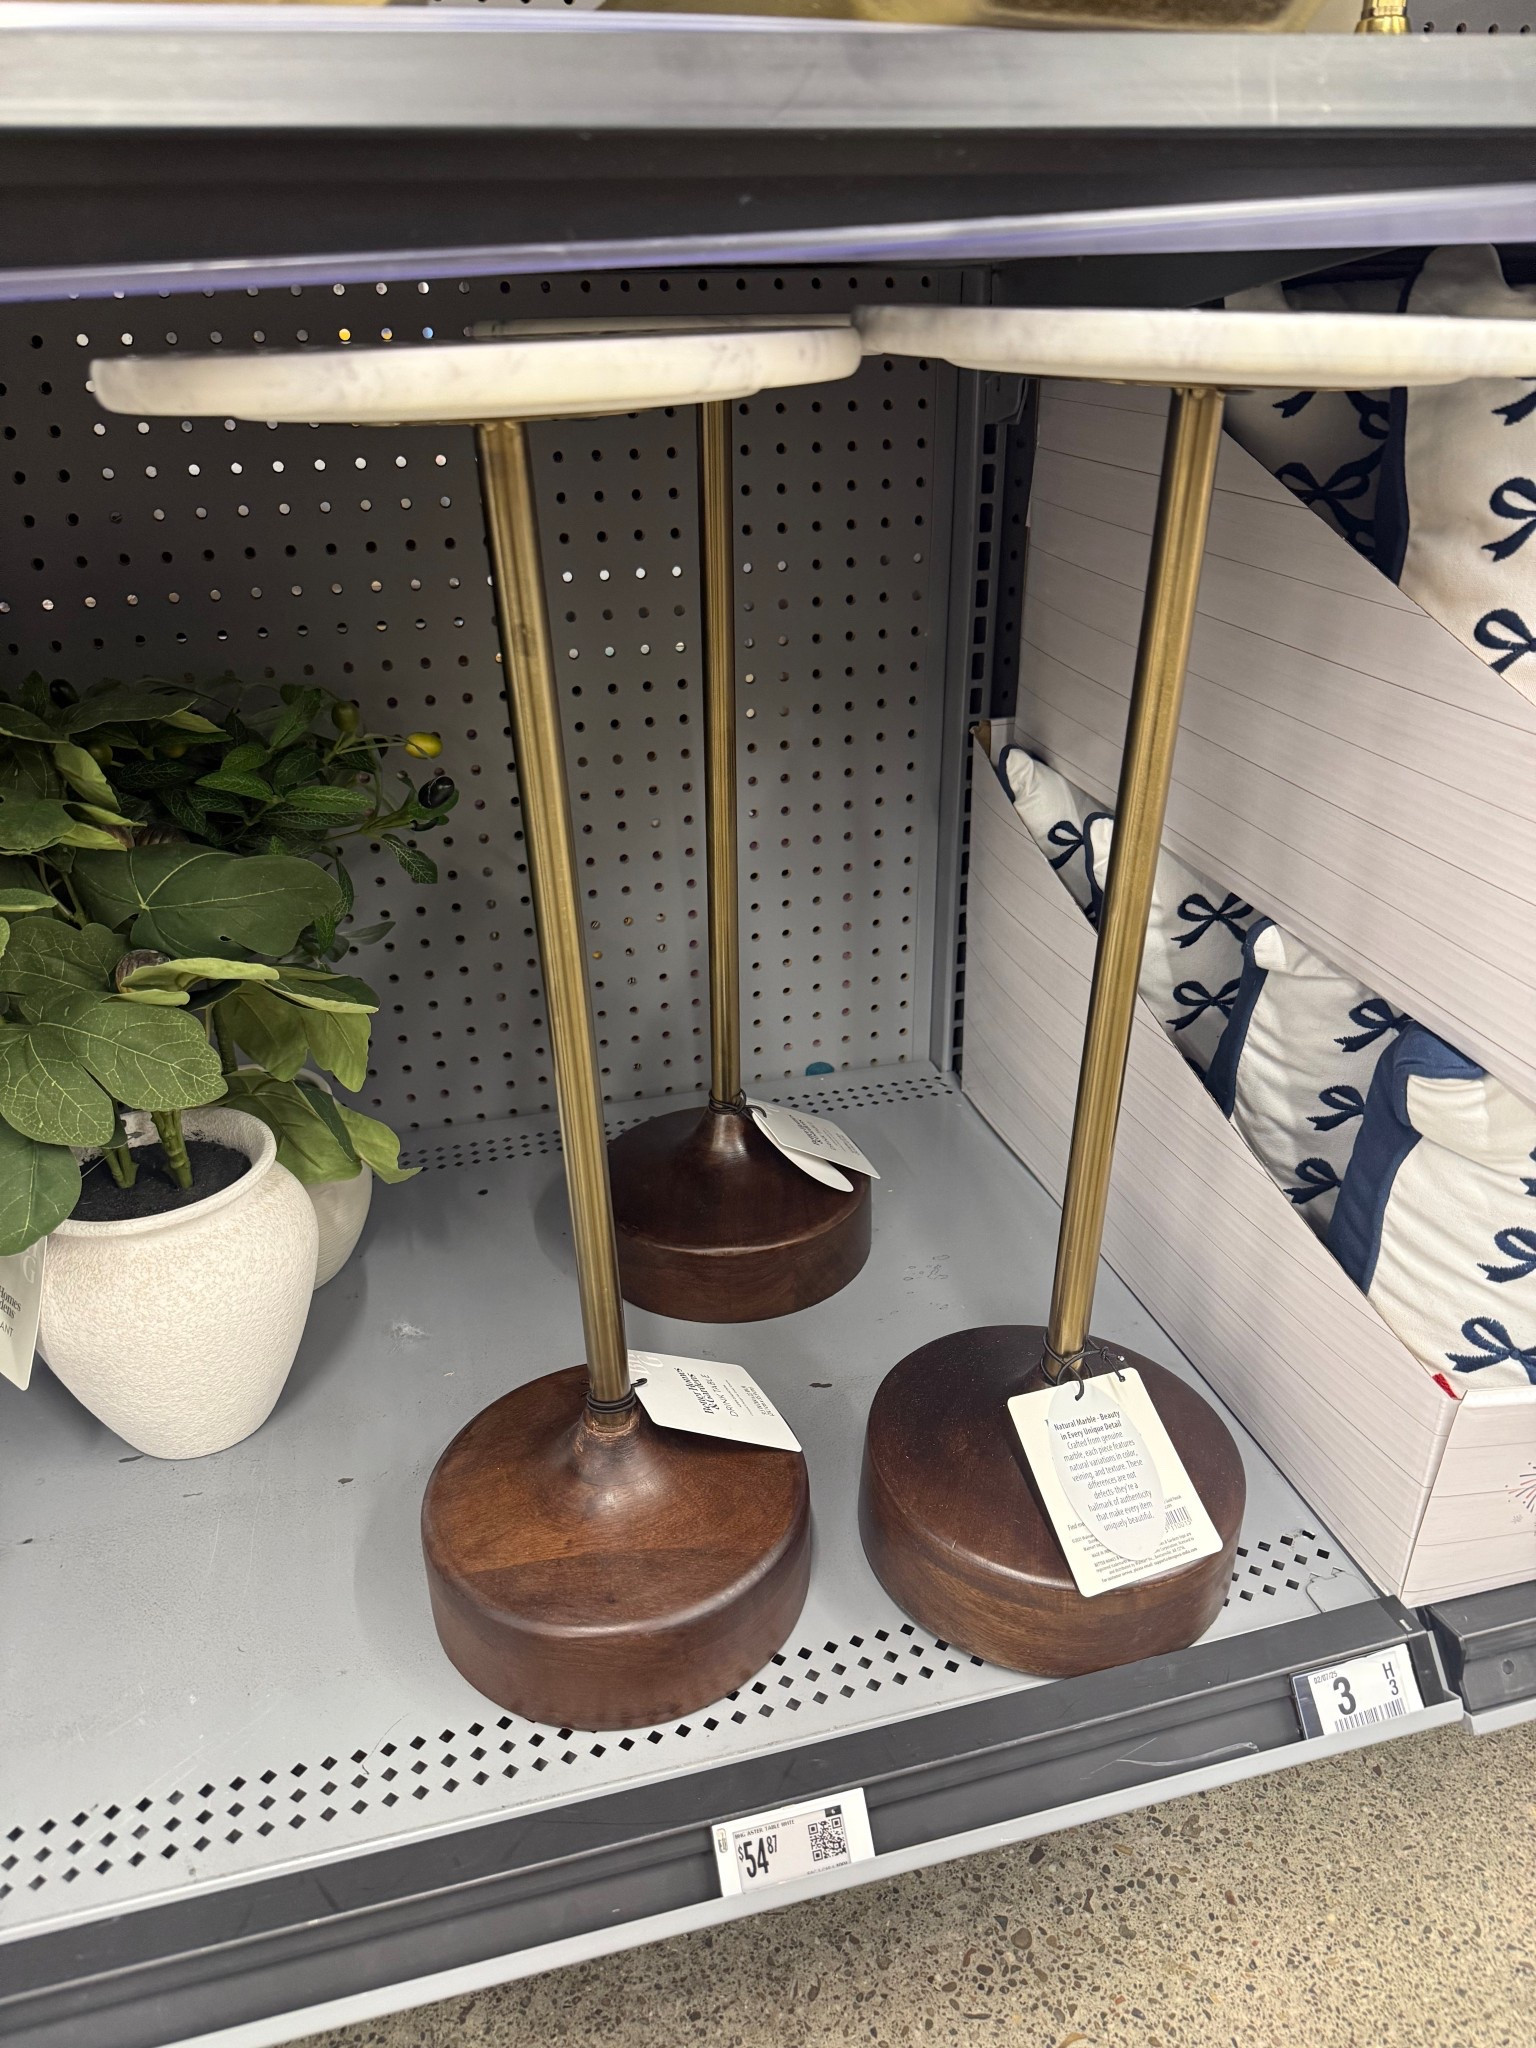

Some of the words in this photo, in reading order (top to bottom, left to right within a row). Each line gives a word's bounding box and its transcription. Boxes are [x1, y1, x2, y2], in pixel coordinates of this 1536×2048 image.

[1054, 1420, 1076, 1431] Natural
[1076, 1416, 1096, 1426] Marble
[1099, 1411, 1120, 1421] Beauty
[1067, 1430, 1084, 1439] Every
[1083, 1425, 1104, 1435] Unique
[1104, 1420, 1122, 1430] Detail
[1067, 1439, 1087, 1450] Crafted
[1087, 1436, 1101, 1445] from
[1101, 1431, 1123, 1443] genuine
[1063, 1450, 1085, 1462] marble,
[1085, 1447, 1099, 1457] each
[1099, 1444, 1112, 1455] piece
[1112, 1439, 1135, 1450] features
[1069, 1460, 1089, 1471] natural
[1089, 1454, 1116, 1466] variations
[1122, 1449, 1138, 1458] color,
[1094, 1468, 1106, 1476] and
[1106, 1463, 1127, 1473] texture.
[1126, 1459, 1144, 1468] These
[1087, 1476, 1118, 1490] differences
[1126, 1471, 1137, 1479] not
[1087, 1500, 1113, 1512] hallmark
[1113, 1497, 1120, 1505] of
[1119, 1490, 1152, 1503] authenticity
[1095, 1512, 1109, 1521] that
[1108, 1508, 1124, 1518] make
[1124, 1505, 1140, 1515] every
[1139, 1501, 1153, 1510] item
[1104, 1519, 1128, 1531] uniquely
[1382, 1662, 1395, 1679] H
[1333, 1677, 1356, 1715] 3
[1389, 1679, 1399, 1696] 3
[747, 1828, 763, 1836] ASTER
[765, 1823, 780, 1831] TABLE
